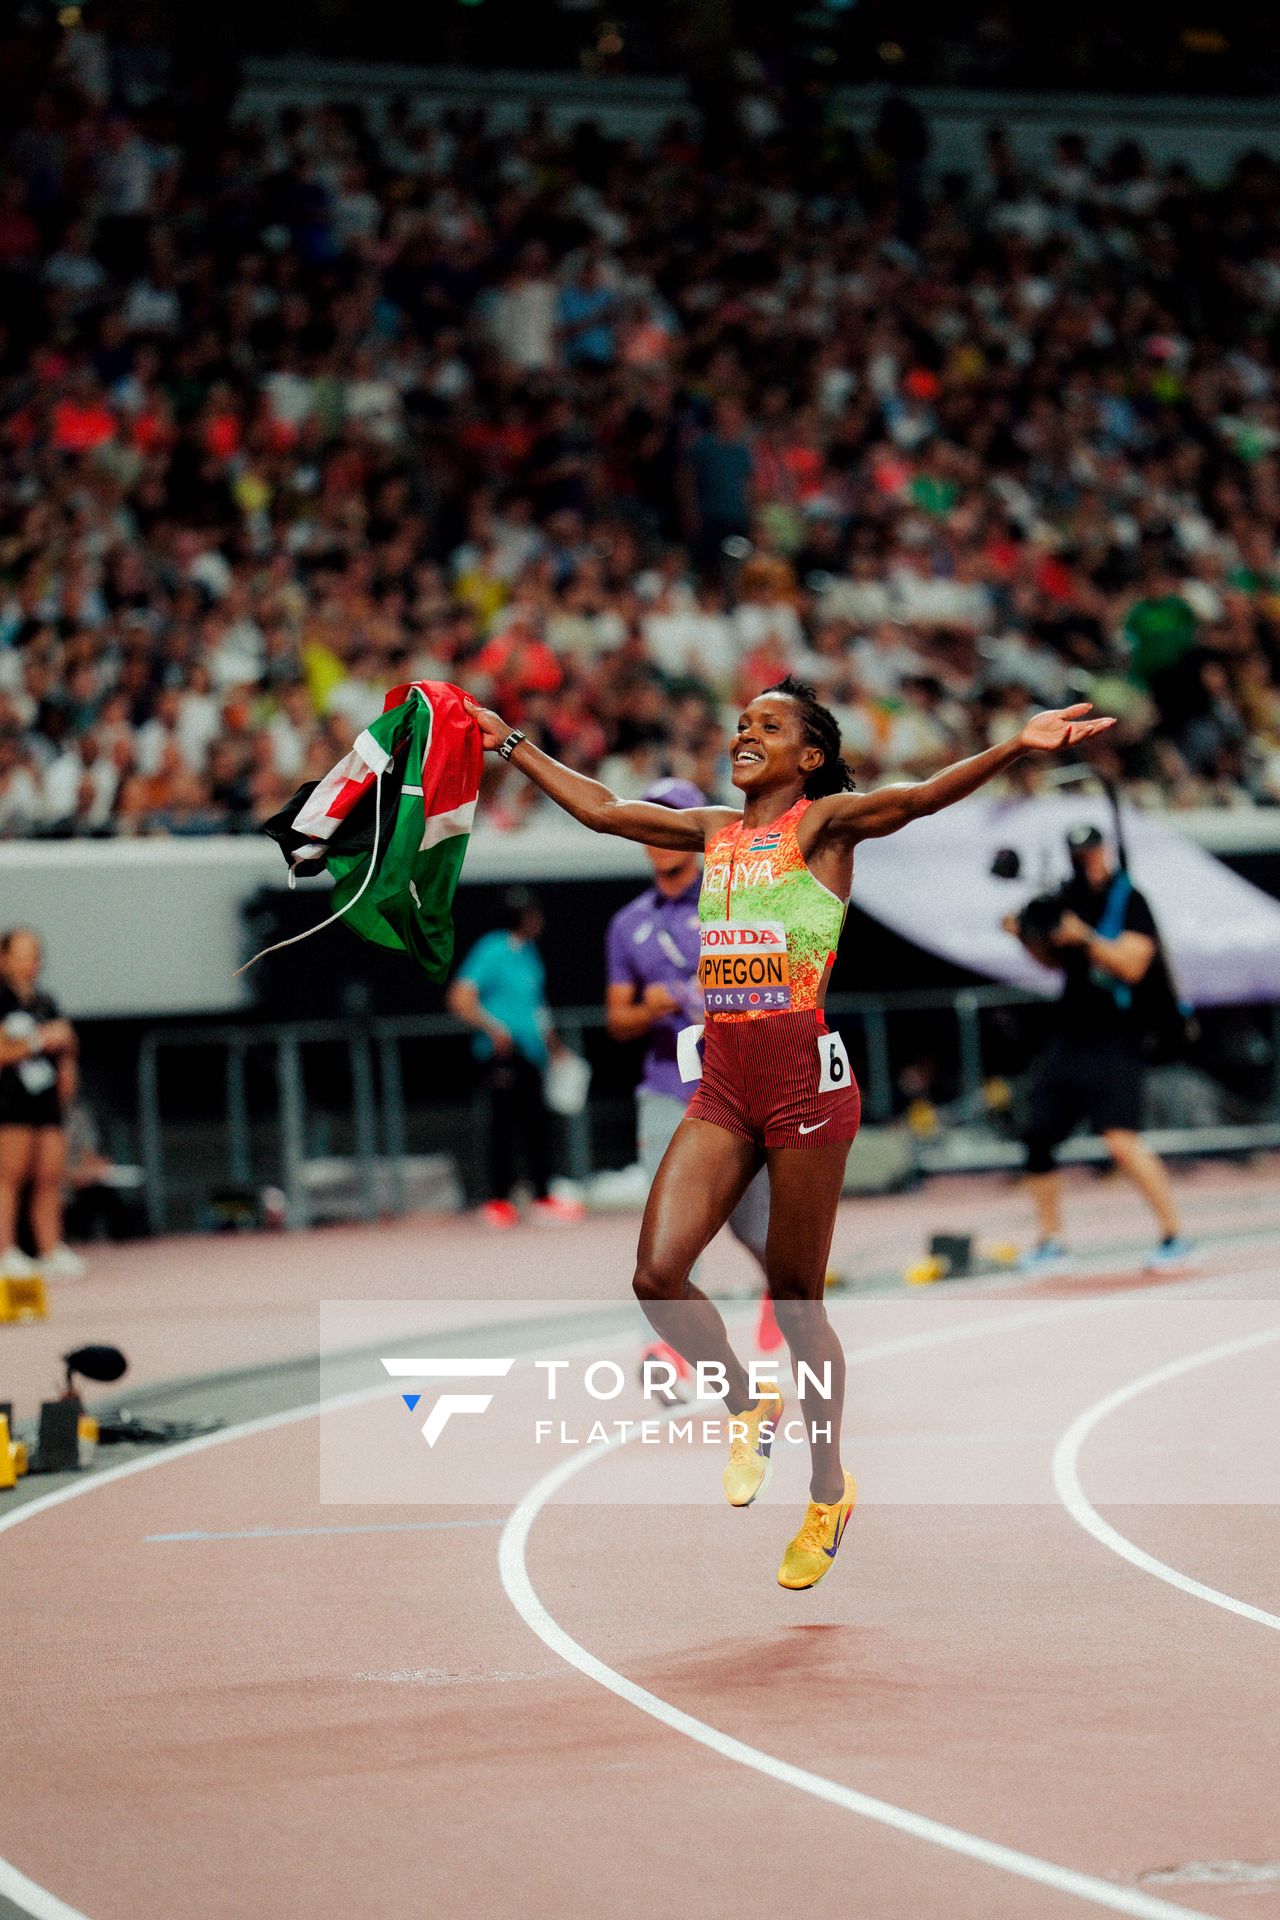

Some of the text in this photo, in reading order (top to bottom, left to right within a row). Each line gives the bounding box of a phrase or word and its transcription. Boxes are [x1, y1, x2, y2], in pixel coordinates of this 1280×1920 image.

[703, 860, 774, 892] KENYA
[701, 929, 782, 946] HONDA
[830, 1043, 844, 1082] 6
